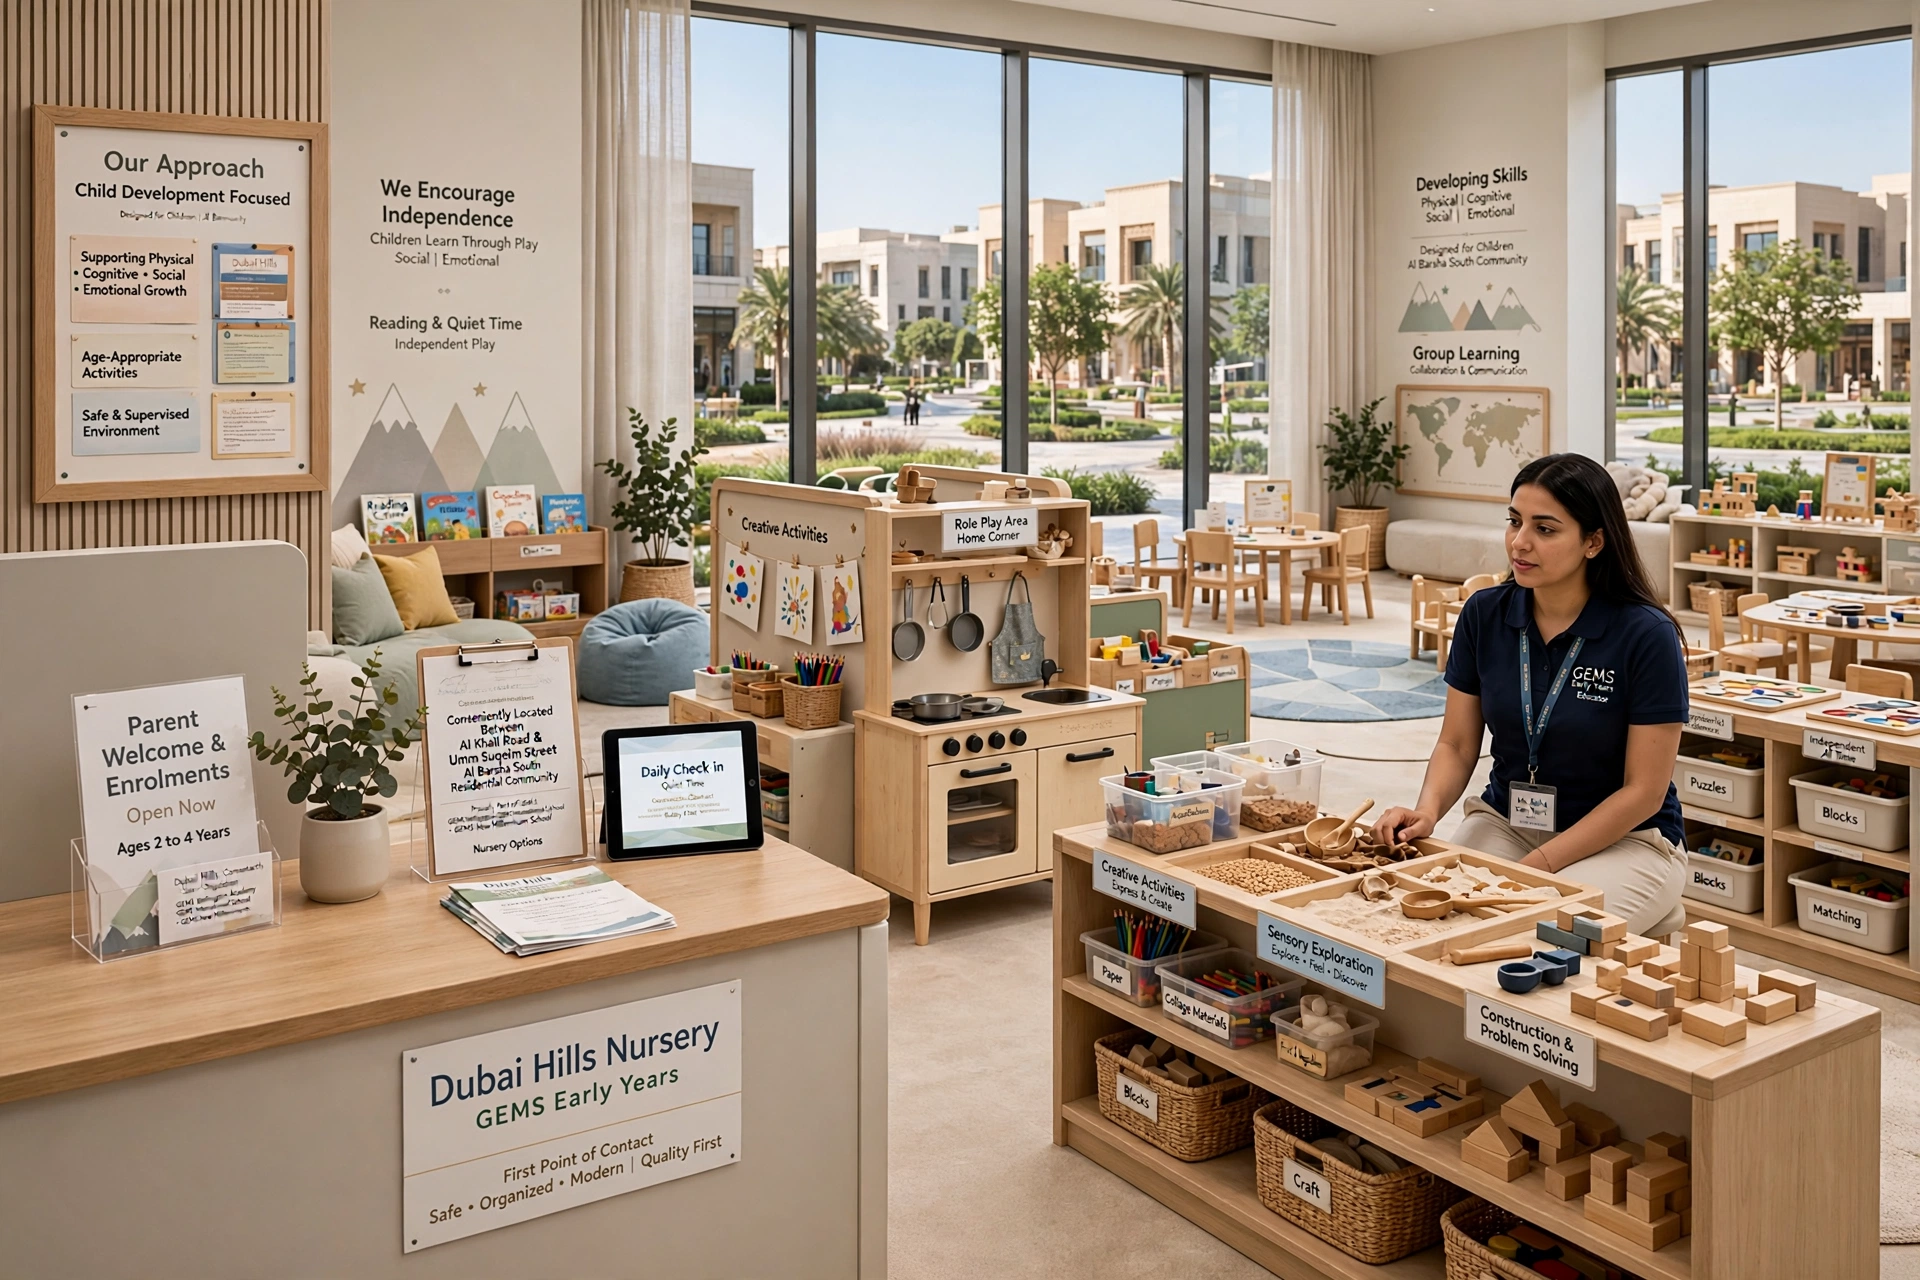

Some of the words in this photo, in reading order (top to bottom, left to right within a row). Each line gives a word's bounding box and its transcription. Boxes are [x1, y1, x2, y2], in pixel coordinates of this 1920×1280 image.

[104, 151, 148, 171] Our
[156, 154, 264, 180] Approach
[1416, 172, 1488, 191] Developing
[1493, 166, 1528, 183] Skills
[75, 183, 116, 198] Child
[122, 185, 225, 204] Development
[230, 190, 291, 205] Focused
[380, 179, 411, 197] We
[418, 181, 515, 207] Encourage
[1421, 194, 1458, 210] Physical
[1467, 190, 1512, 206] Cognitive
[382, 205, 514, 229] Independence
[1426, 208, 1453, 223] Social
[1467, 204, 1515, 220] Emotional
[370, 232, 422, 246] Children
[426, 234, 459, 247] Learn
[462, 235, 511, 251] Through
[515, 237, 538, 253] Play
[1420, 244, 1459, 257] Designed
[1462, 243, 1473, 253] for
[1476, 240, 1514, 252] Children
[81, 251, 146, 266] Supporting
[149, 252, 194, 266] Physical
[394, 252, 430, 264] Social
[442, 253, 500, 266] Emotional
[1408, 259, 1417, 269] Al
[1419, 257, 1447, 269] Barsha
[1449, 256, 1474, 267] South
[1476, 253, 1528, 268] Community
[83, 268, 139, 282] Cognitive
[153, 269, 186, 281] Social
[83, 284, 141, 296] Emotional
[144, 285, 187, 298] Growth
[370, 316, 427, 333] Reading
[432, 316, 443, 329] &
[447, 316, 485, 332] Quiet
[489, 317, 523, 330] Time
[395, 338, 468, 352] Independent
[472, 338, 495, 352] Play
[1413, 346, 1455, 363] Group
[1459, 346, 1520, 363] Learning
[82, 351, 182, 366] Age-Appropriate
[82, 366, 138, 379] Activities
[1410, 366, 1458, 376] Collaboration
[1460, 365, 1466, 375] &
[82, 409, 109, 421] Safe
[112, 410, 122, 421] &
[125, 408, 190, 424] Supervised
[83, 425, 160, 437] Environment
[742, 517, 780, 536] Creative
[782, 522, 828, 543] Activities
[955, 518, 978, 530] Role
[981, 516, 1002, 531] Play
[1005, 516, 1028, 526] Area
[957, 533, 986, 544] Home
[988, 531, 1020, 542] Corner
[1573, 666, 1615, 683] GEMS
[514, 705, 553, 718] Located
[128, 710, 199, 736] Parent
[460, 739, 471, 750] Al
[503, 732, 530, 746] Road
[533, 731, 542, 742] &
[1810, 735, 1865, 754] Independent
[102, 741, 203, 768] Welcome
[211, 734, 226, 752] &
[449, 754, 479, 766] Umm
[481, 748, 521, 766] Suqeim
[524, 745, 557, 758] Street
[464, 766, 475, 778] Al
[505, 771, 559, 786] Community
[641, 764, 670, 779] Daily
[673, 761, 709, 775] Check
[713, 761, 724, 772] in
[106, 763, 230, 797] Enrolments
[1690, 777, 1727, 795] Puzzles
[127, 805, 174, 825] Open
[179, 799, 216, 816] Now
[1822, 807, 1858, 825] Blocks
[117, 840, 150, 857] Ages
[153, 836, 163, 849] 2
[165, 835, 181, 847] to
[183, 831, 194, 844] 4
[196, 826, 230, 842] Years
[473, 843, 507, 853] Nursery
[510, 837, 543, 850] Options
[1101, 860, 1139, 884] Creative
[1141, 875, 1185, 901] Activities
[1694, 872, 1726, 891] Blocks
[1141, 890, 1146, 901] &
[1148, 894, 1172, 912] Create
[1813, 904, 1862, 929] Matching
[1268, 924, 1308, 954] Sensory
[1311, 941, 1374, 976] Exploration
[1102, 965, 1123, 984] Paper
[1271, 944, 1300, 964] Explore
[1309, 959, 1325, 974] Feel
[1333, 968, 1368, 991] Discover
[1165, 993, 1191, 1015] Collage
[1193, 1005, 1227, 1031] Materials
[1480, 1005, 1560, 1047] Construction
[1563, 1036, 1574, 1053] &
[1480, 1023, 1530, 1054] Problem
[1533, 1043, 1579, 1077] Solving
[430, 1057, 523, 1106] Dubai
[533, 1043, 597, 1083] Hills
[606, 1021, 720, 1066] Nursery
[476, 1096, 546, 1129] GEMS
[554, 1082, 612, 1111] Early
[620, 1068, 680, 1095] Years
[503, 1162, 536, 1184] First
[540, 1152, 578, 1174] Point
[582, 1145, 597, 1163] of
[600, 1133, 654, 1157] Contact
[429, 1203, 463, 1225] Safe
[479, 1178, 554, 1211] Organized
[570, 1163, 624, 1187] Modern
[641, 1144, 689, 1170] Quality
[693, 1135, 722, 1154] First
[1293, 1173, 1321, 1199] Craft
